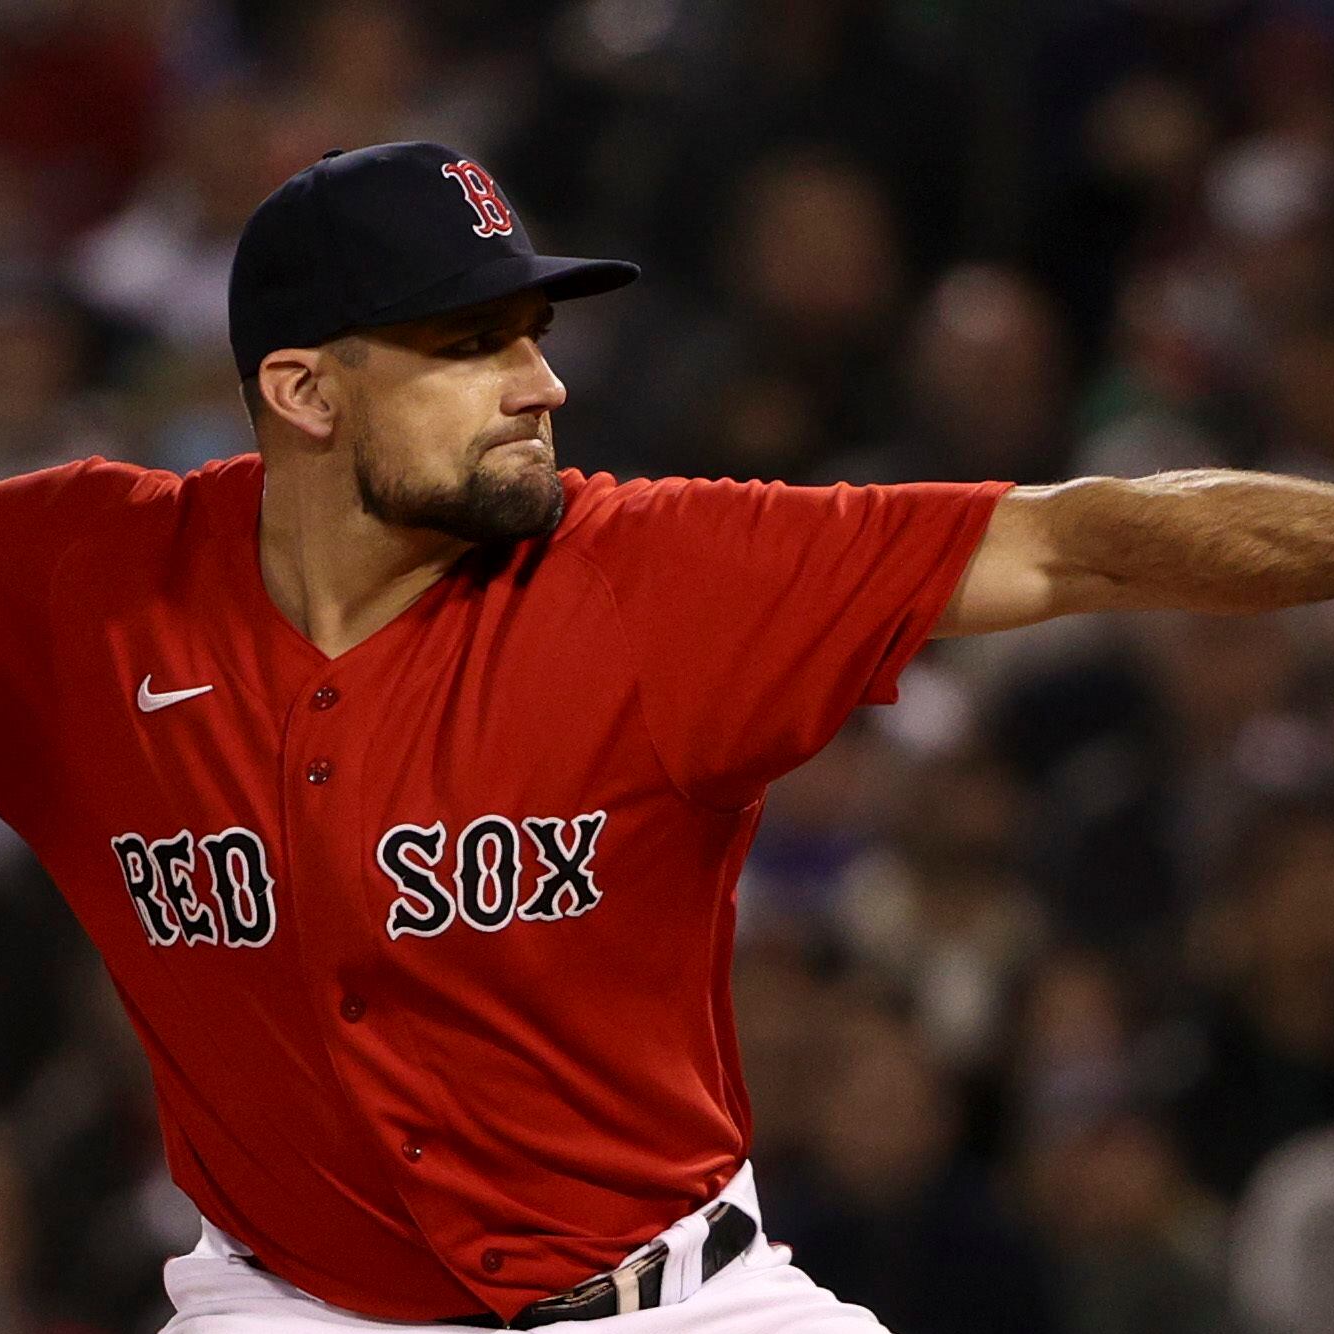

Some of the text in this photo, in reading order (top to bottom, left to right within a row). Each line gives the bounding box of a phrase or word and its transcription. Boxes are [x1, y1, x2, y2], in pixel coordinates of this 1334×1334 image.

[441, 160, 513, 238] B
[111, 810, 607, 948] RED SOX
